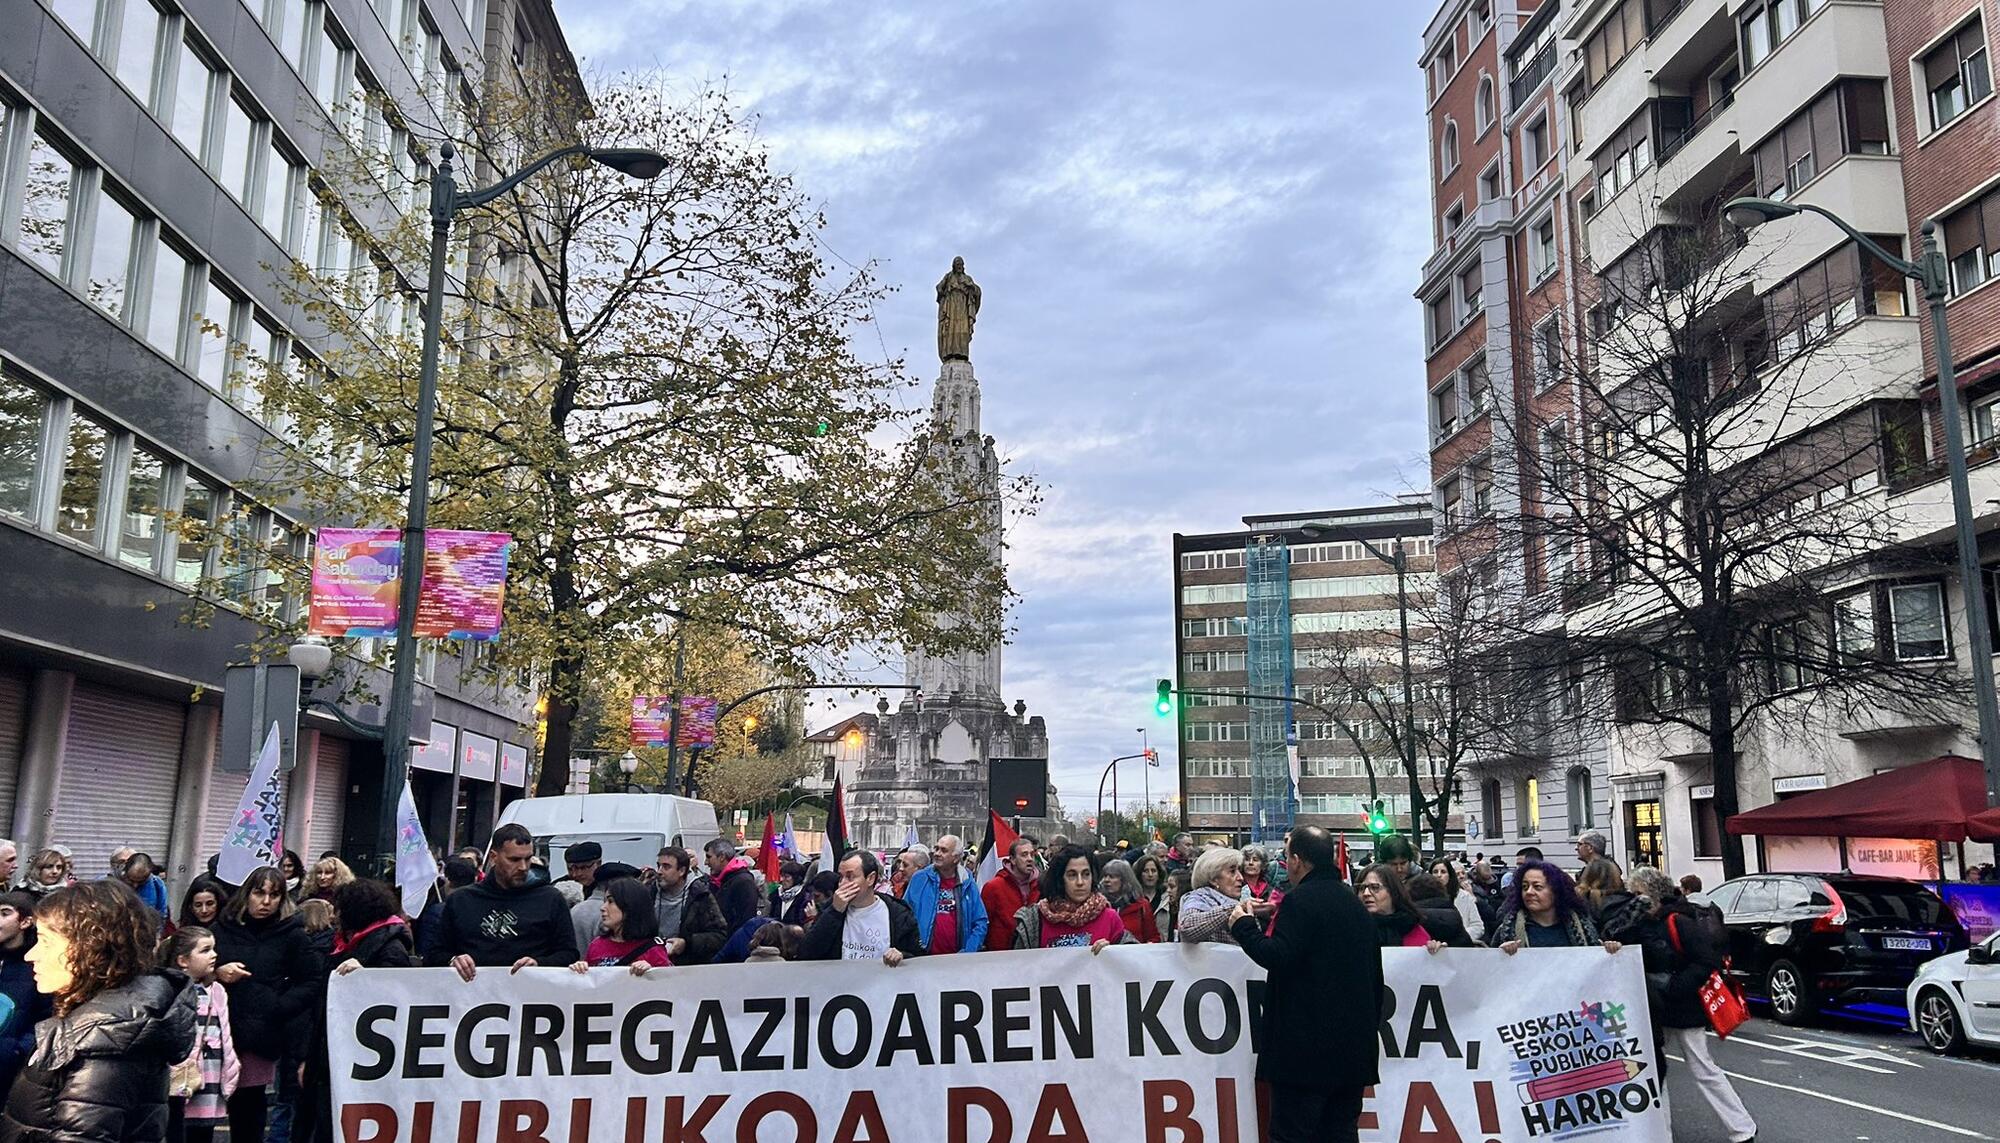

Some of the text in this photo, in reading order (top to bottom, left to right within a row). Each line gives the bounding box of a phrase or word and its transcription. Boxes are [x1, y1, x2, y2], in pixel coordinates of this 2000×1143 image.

[317, 559, 398, 581] Saturday
[1858, 849, 1917, 863] CAFE-BAR JAIME
[352, 978, 1481, 1080] SEGREGAZIOAREN KOA,
[1497, 1010, 1582, 1044] EUSKAL
[1513, 1027, 1598, 1060] ESKOLA
[1529, 1037, 1642, 1077] PUBLIKOAZ
[342, 1078, 1501, 1143] PUBLIKOA DA BIA!
[1521, 1077, 1661, 1137] HARRO!
